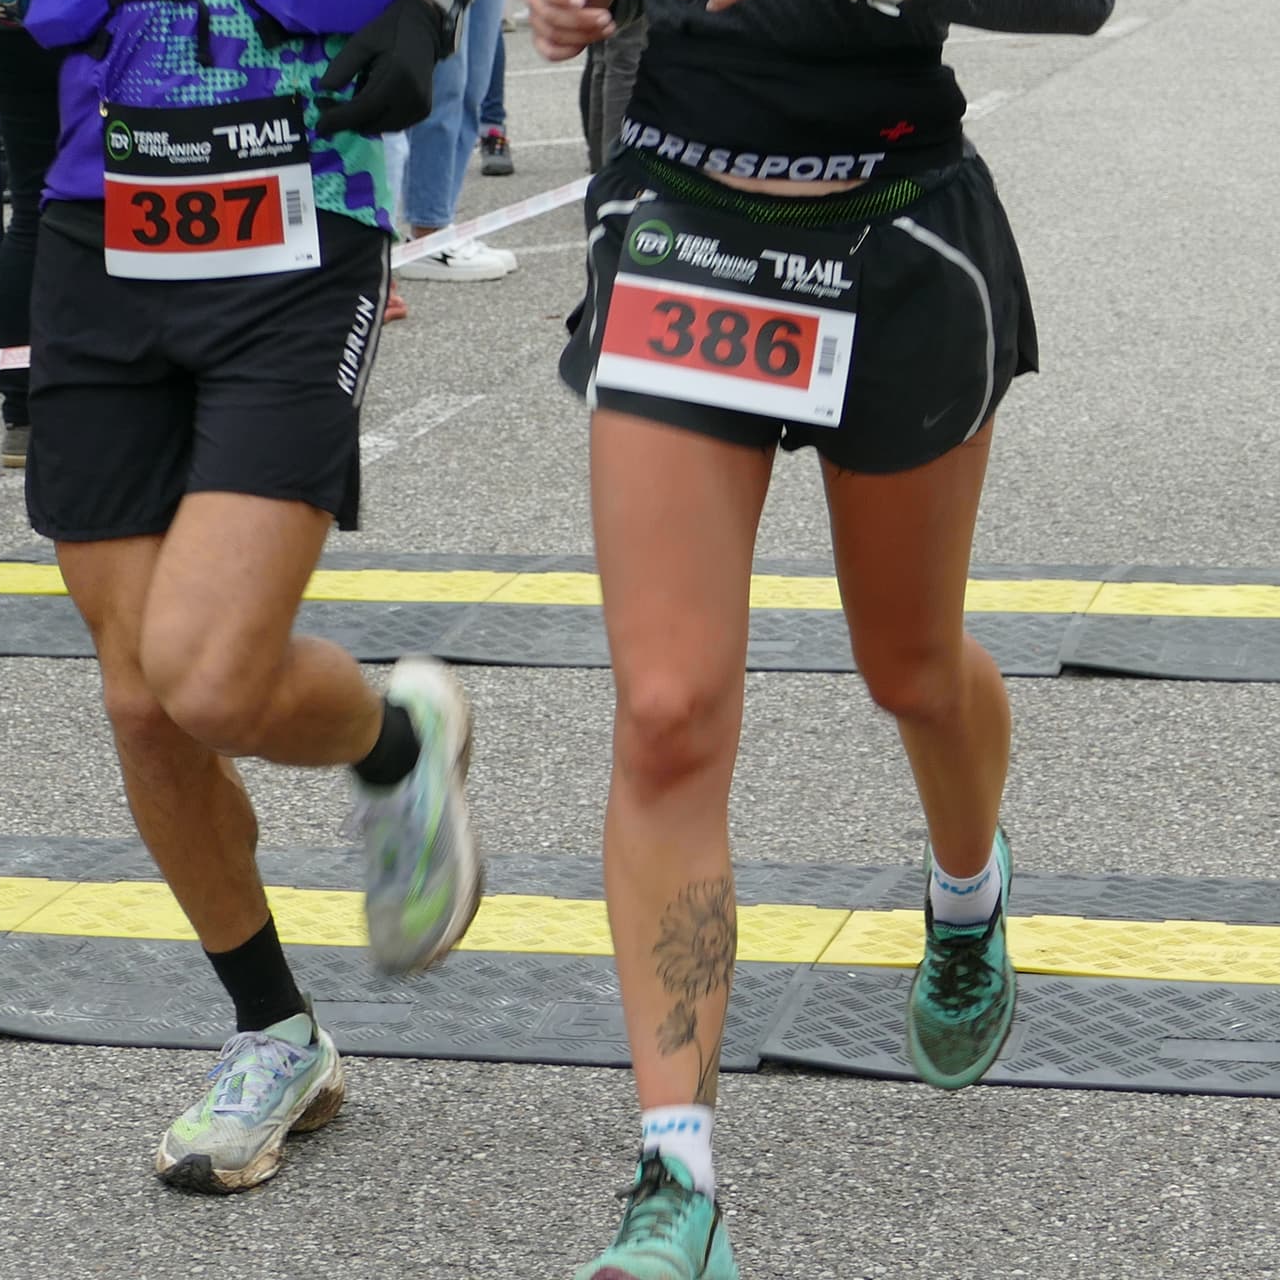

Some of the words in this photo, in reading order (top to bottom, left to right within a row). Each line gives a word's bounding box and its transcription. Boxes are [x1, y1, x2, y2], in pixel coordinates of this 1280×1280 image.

[150, 141, 212, 157] RUNNING
[212, 118, 300, 151] TRAIL
[621, 115, 885, 181] MPRESSPORT
[130, 184, 268, 246] 387
[760, 249, 854, 291] TRAIL
[336, 293, 376, 396] KIPRUN
[646, 299, 804, 378] 386
